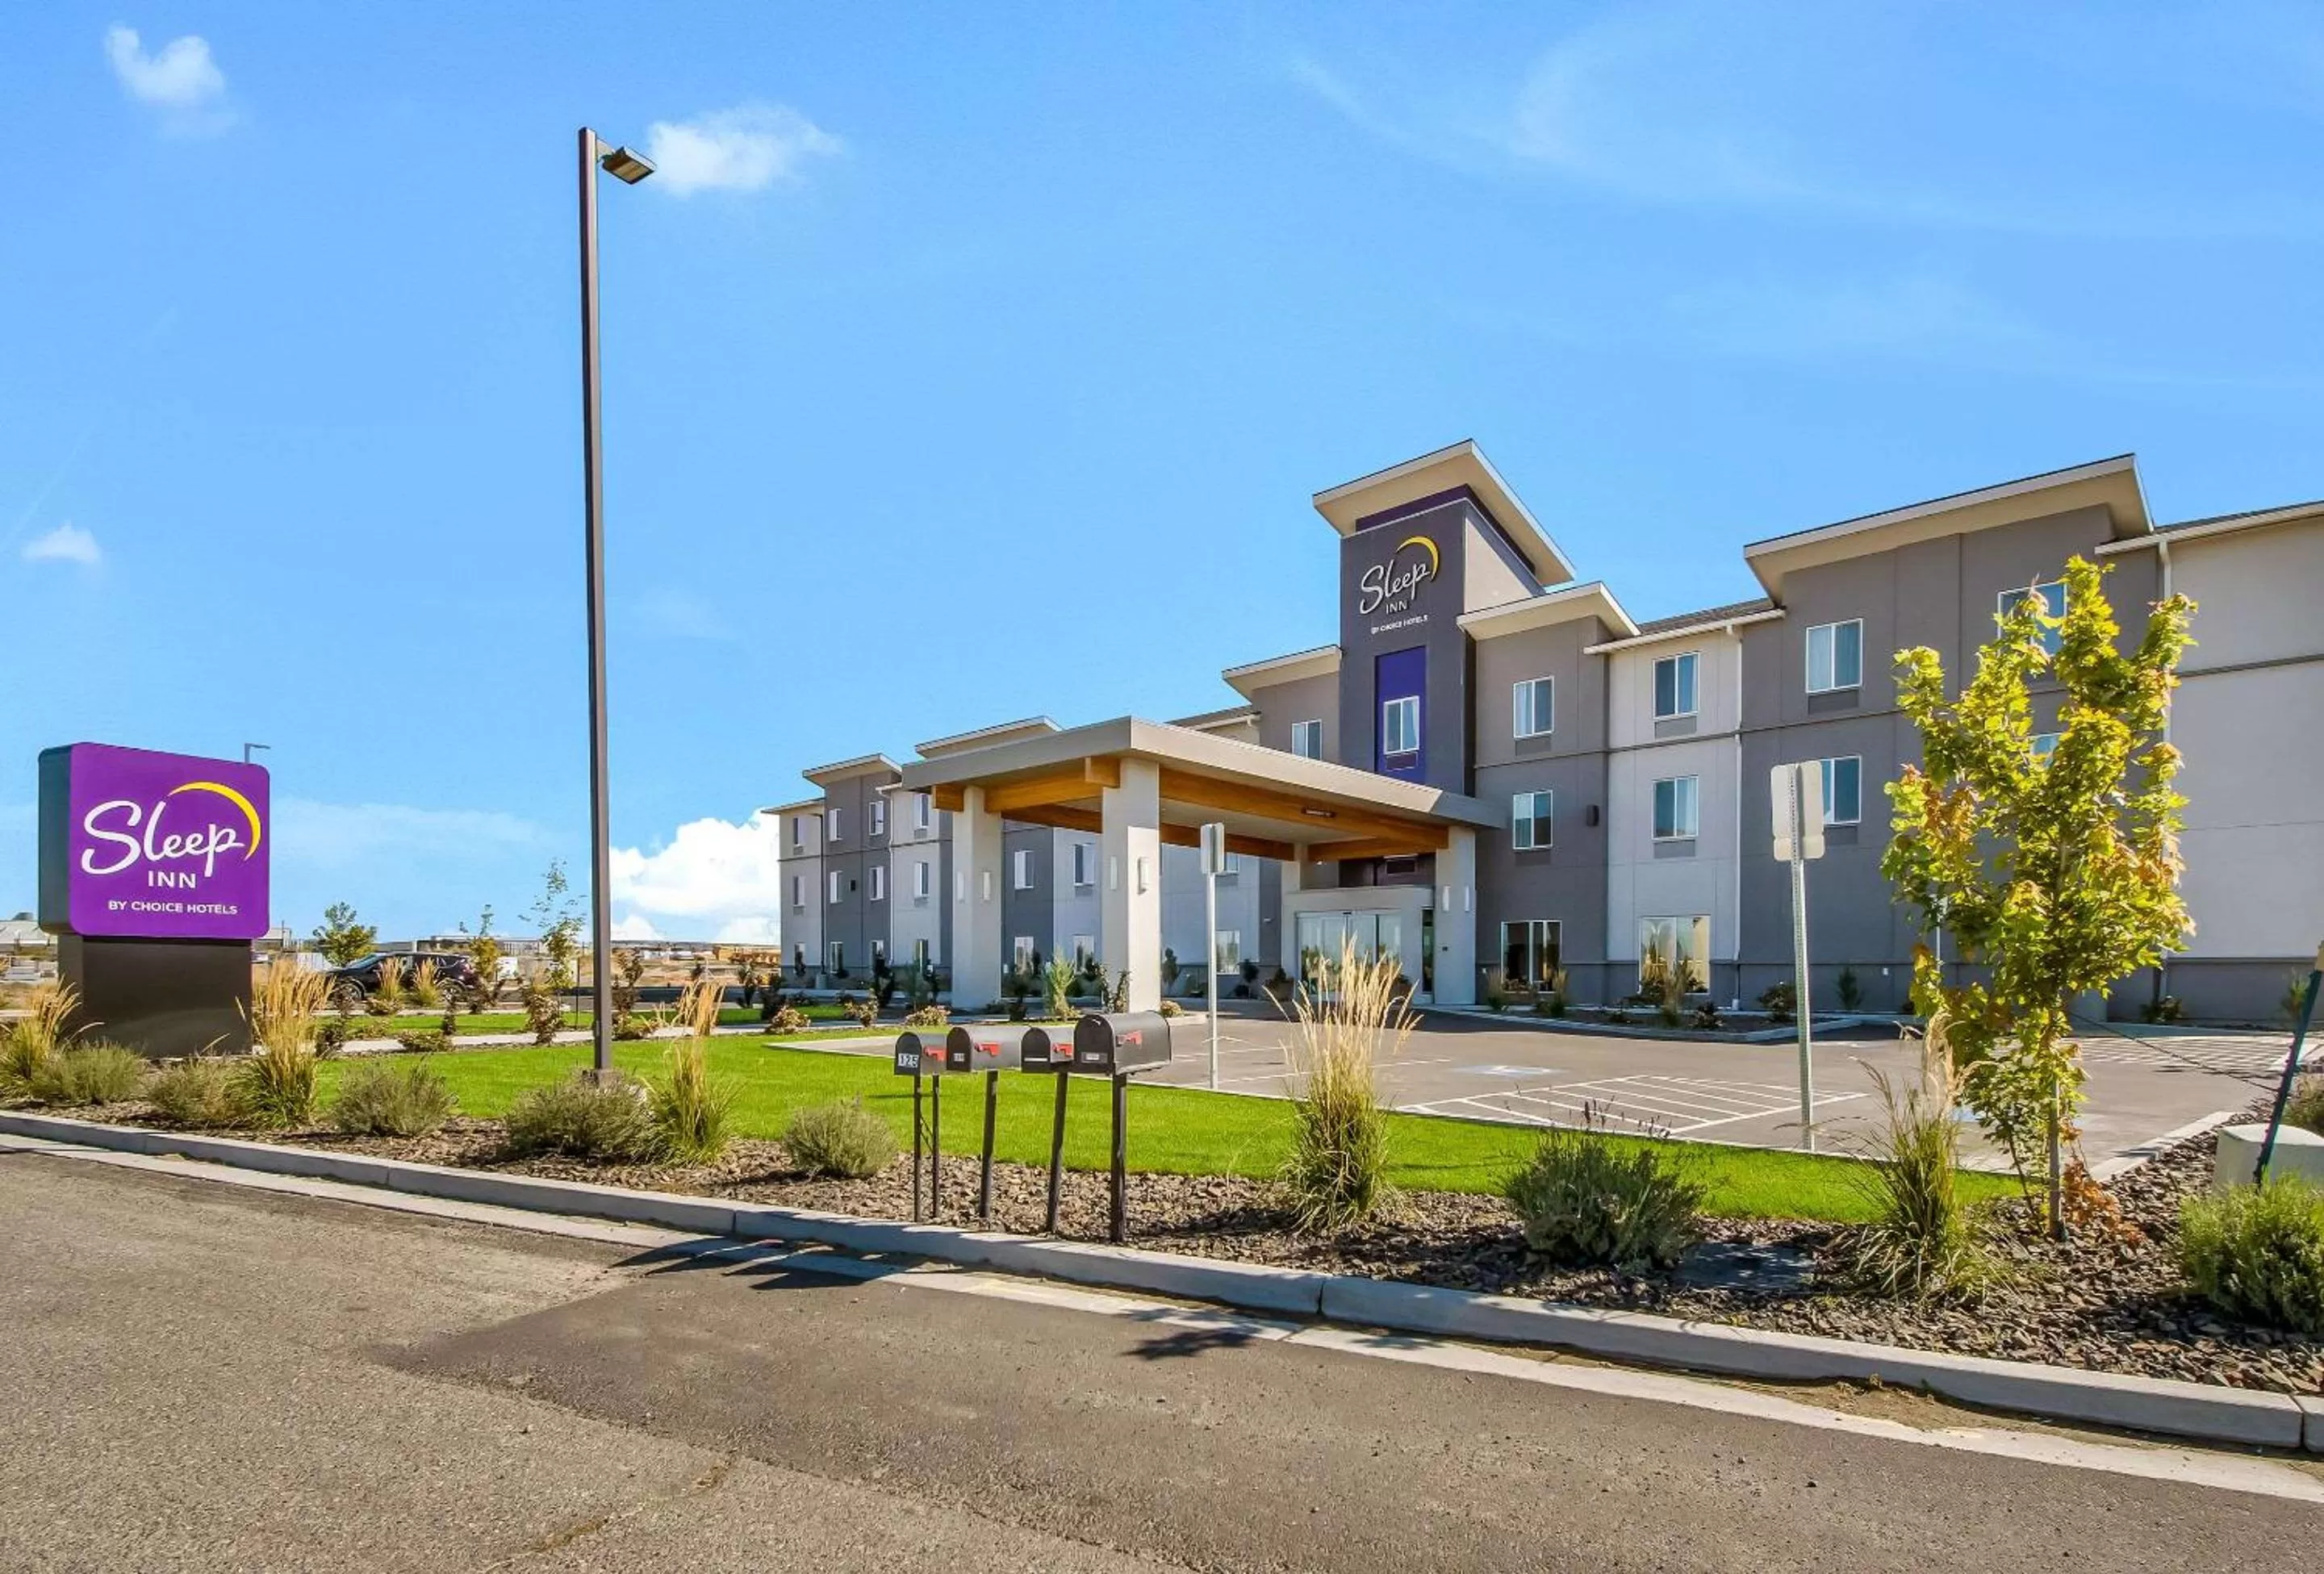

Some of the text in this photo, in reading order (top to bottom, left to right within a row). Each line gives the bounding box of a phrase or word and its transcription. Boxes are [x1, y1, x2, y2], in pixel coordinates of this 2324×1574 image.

[1360, 559, 1431, 615] Sleep
[1386, 600, 1407, 614] INN
[1403, 615, 1428, 627] HOTELS
[82, 800, 245, 877] Sleep
[148, 871, 196, 888] INN
[108, 900, 237, 914] BY CHOICE HOTELS
